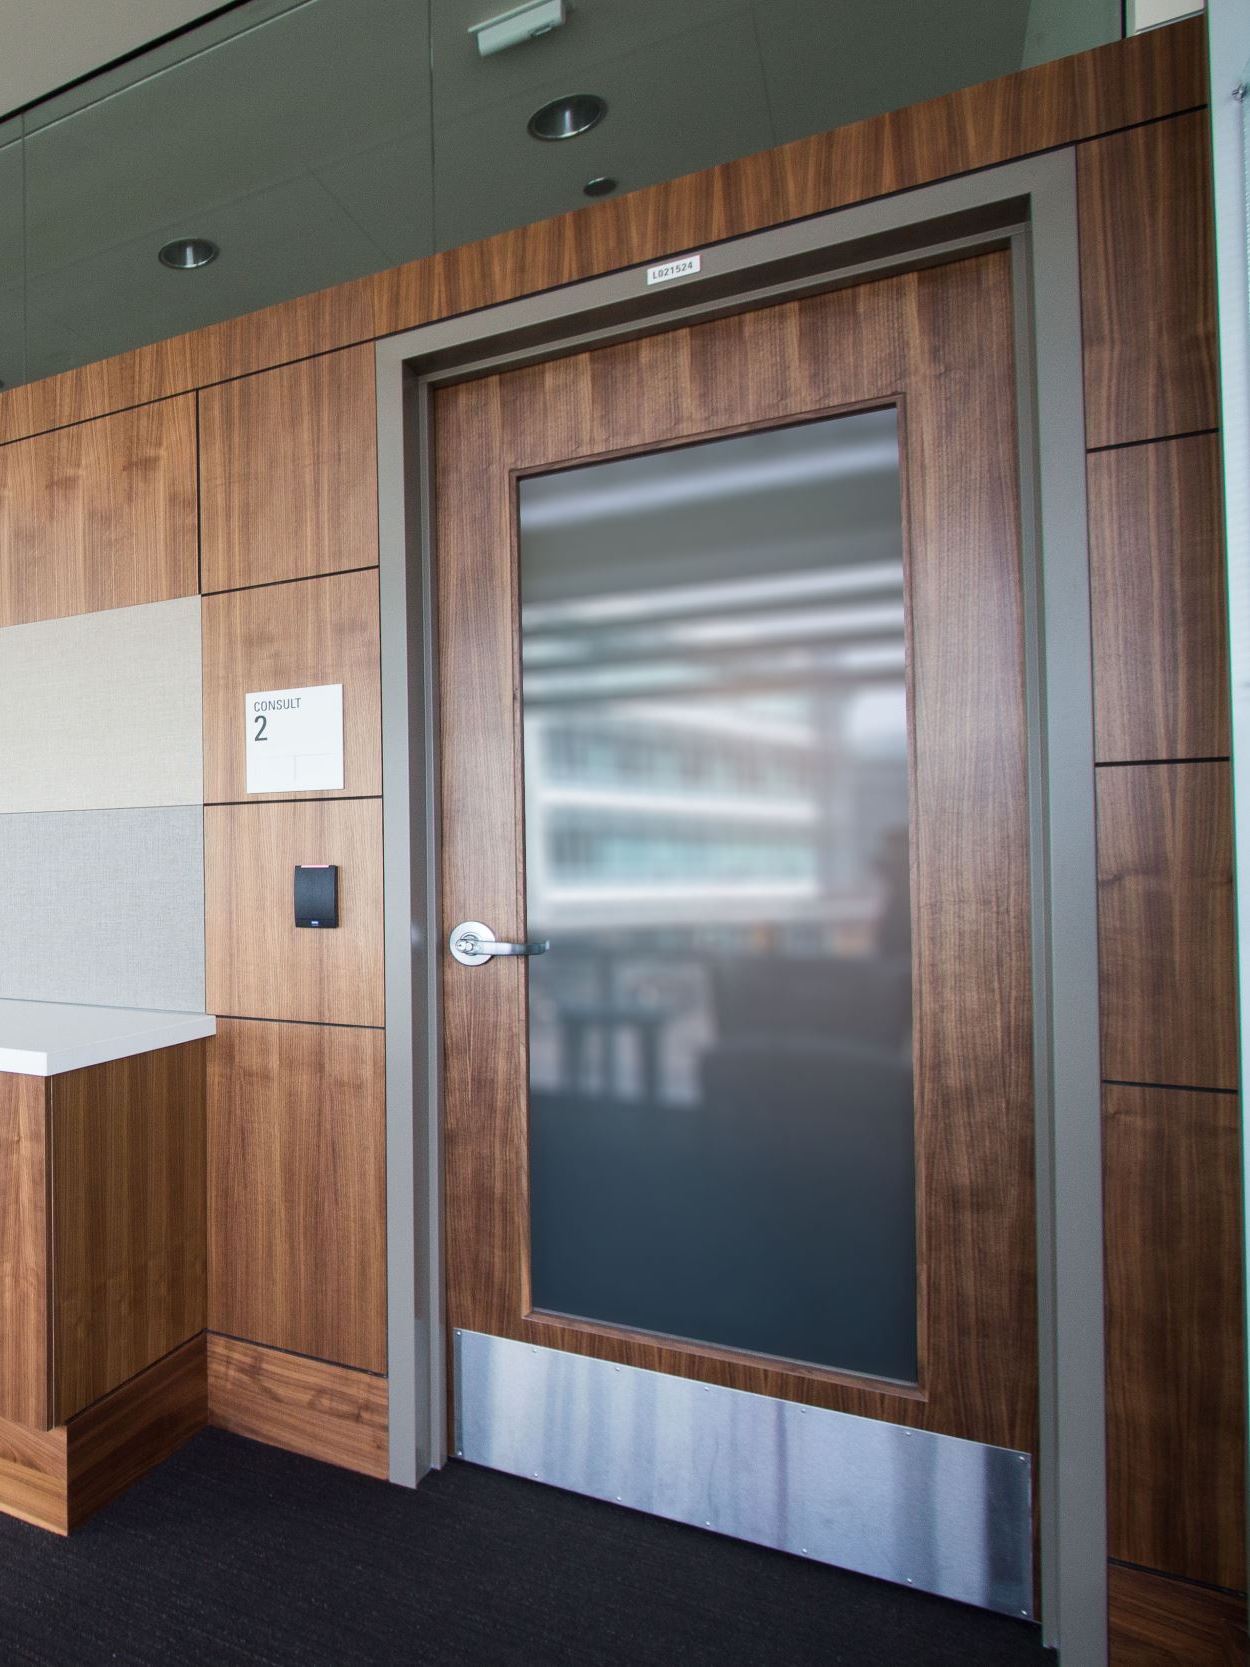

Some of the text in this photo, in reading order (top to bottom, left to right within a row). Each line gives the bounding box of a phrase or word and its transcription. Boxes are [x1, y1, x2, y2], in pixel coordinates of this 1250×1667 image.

[652, 261, 693, 279] L021524
[253, 697, 301, 712] CONSULT
[253, 715, 268, 741] 2
